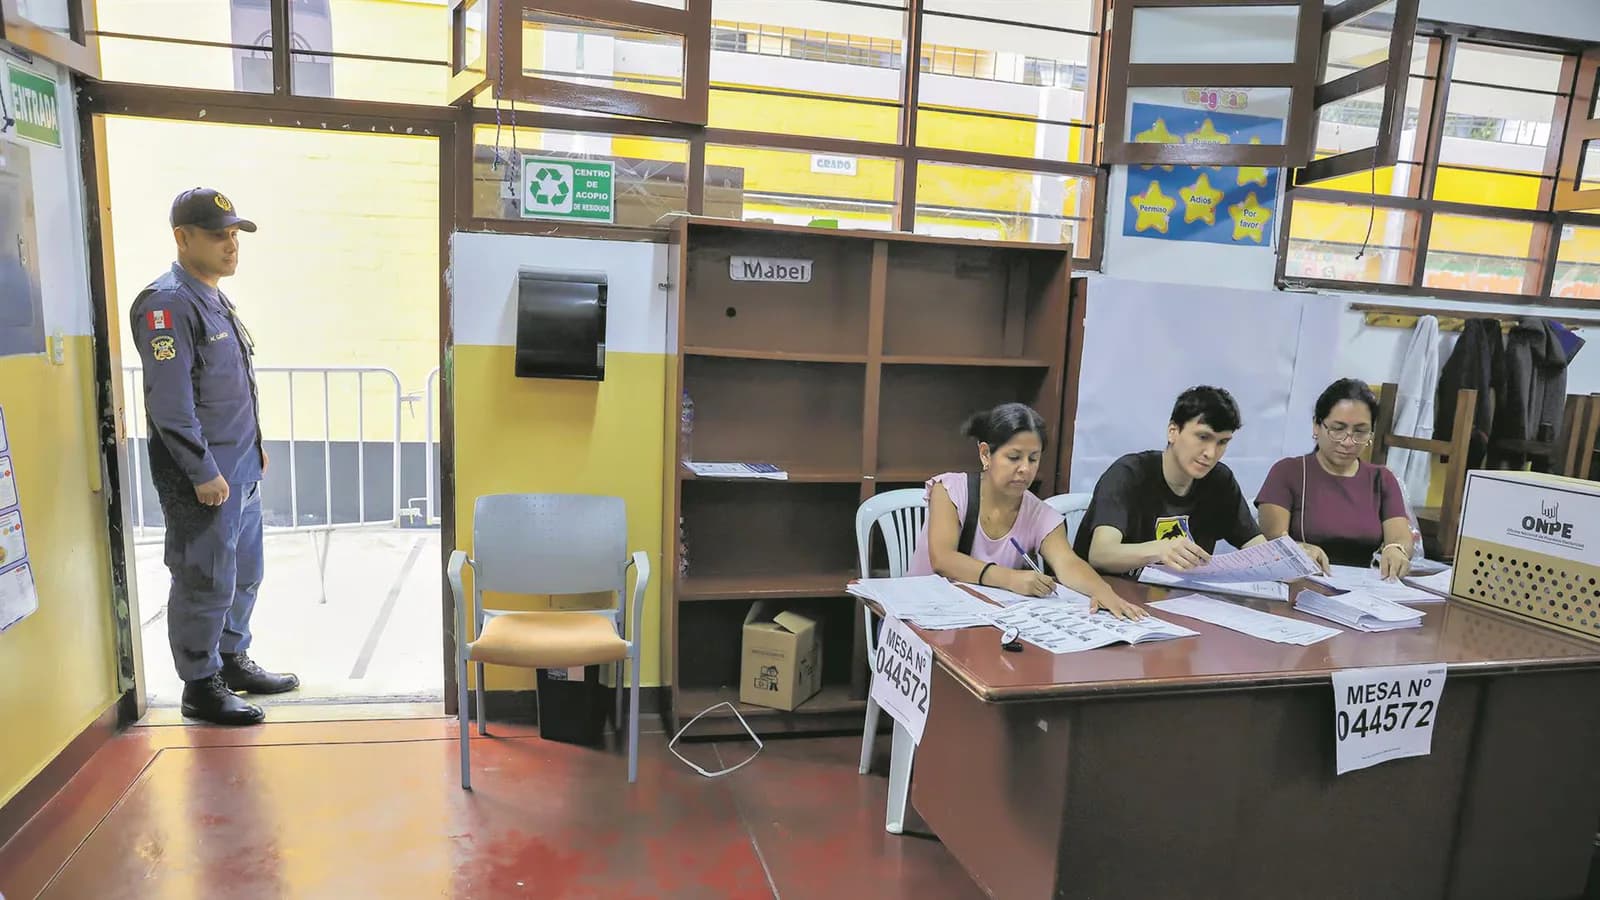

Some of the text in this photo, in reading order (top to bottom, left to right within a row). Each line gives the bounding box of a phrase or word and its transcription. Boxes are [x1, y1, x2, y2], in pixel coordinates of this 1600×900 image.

[11, 82, 58, 130] ENTRADA
[574, 168, 610, 178] CENTRO
[586, 180, 598, 189] DE
[575, 191, 608, 200] ACOPIO
[1139, 204, 1168, 214] Permiso
[1243, 208, 1257, 217] Por
[1239, 219, 1259, 228] favor
[743, 260, 805, 280] Mabel
[1522, 516, 1573, 539] ONPE
[886, 628, 913, 665] MESA
[876, 646, 928, 714] 044572
[1346, 680, 1402, 705] MESA
[1337, 700, 1434, 742] 044572
